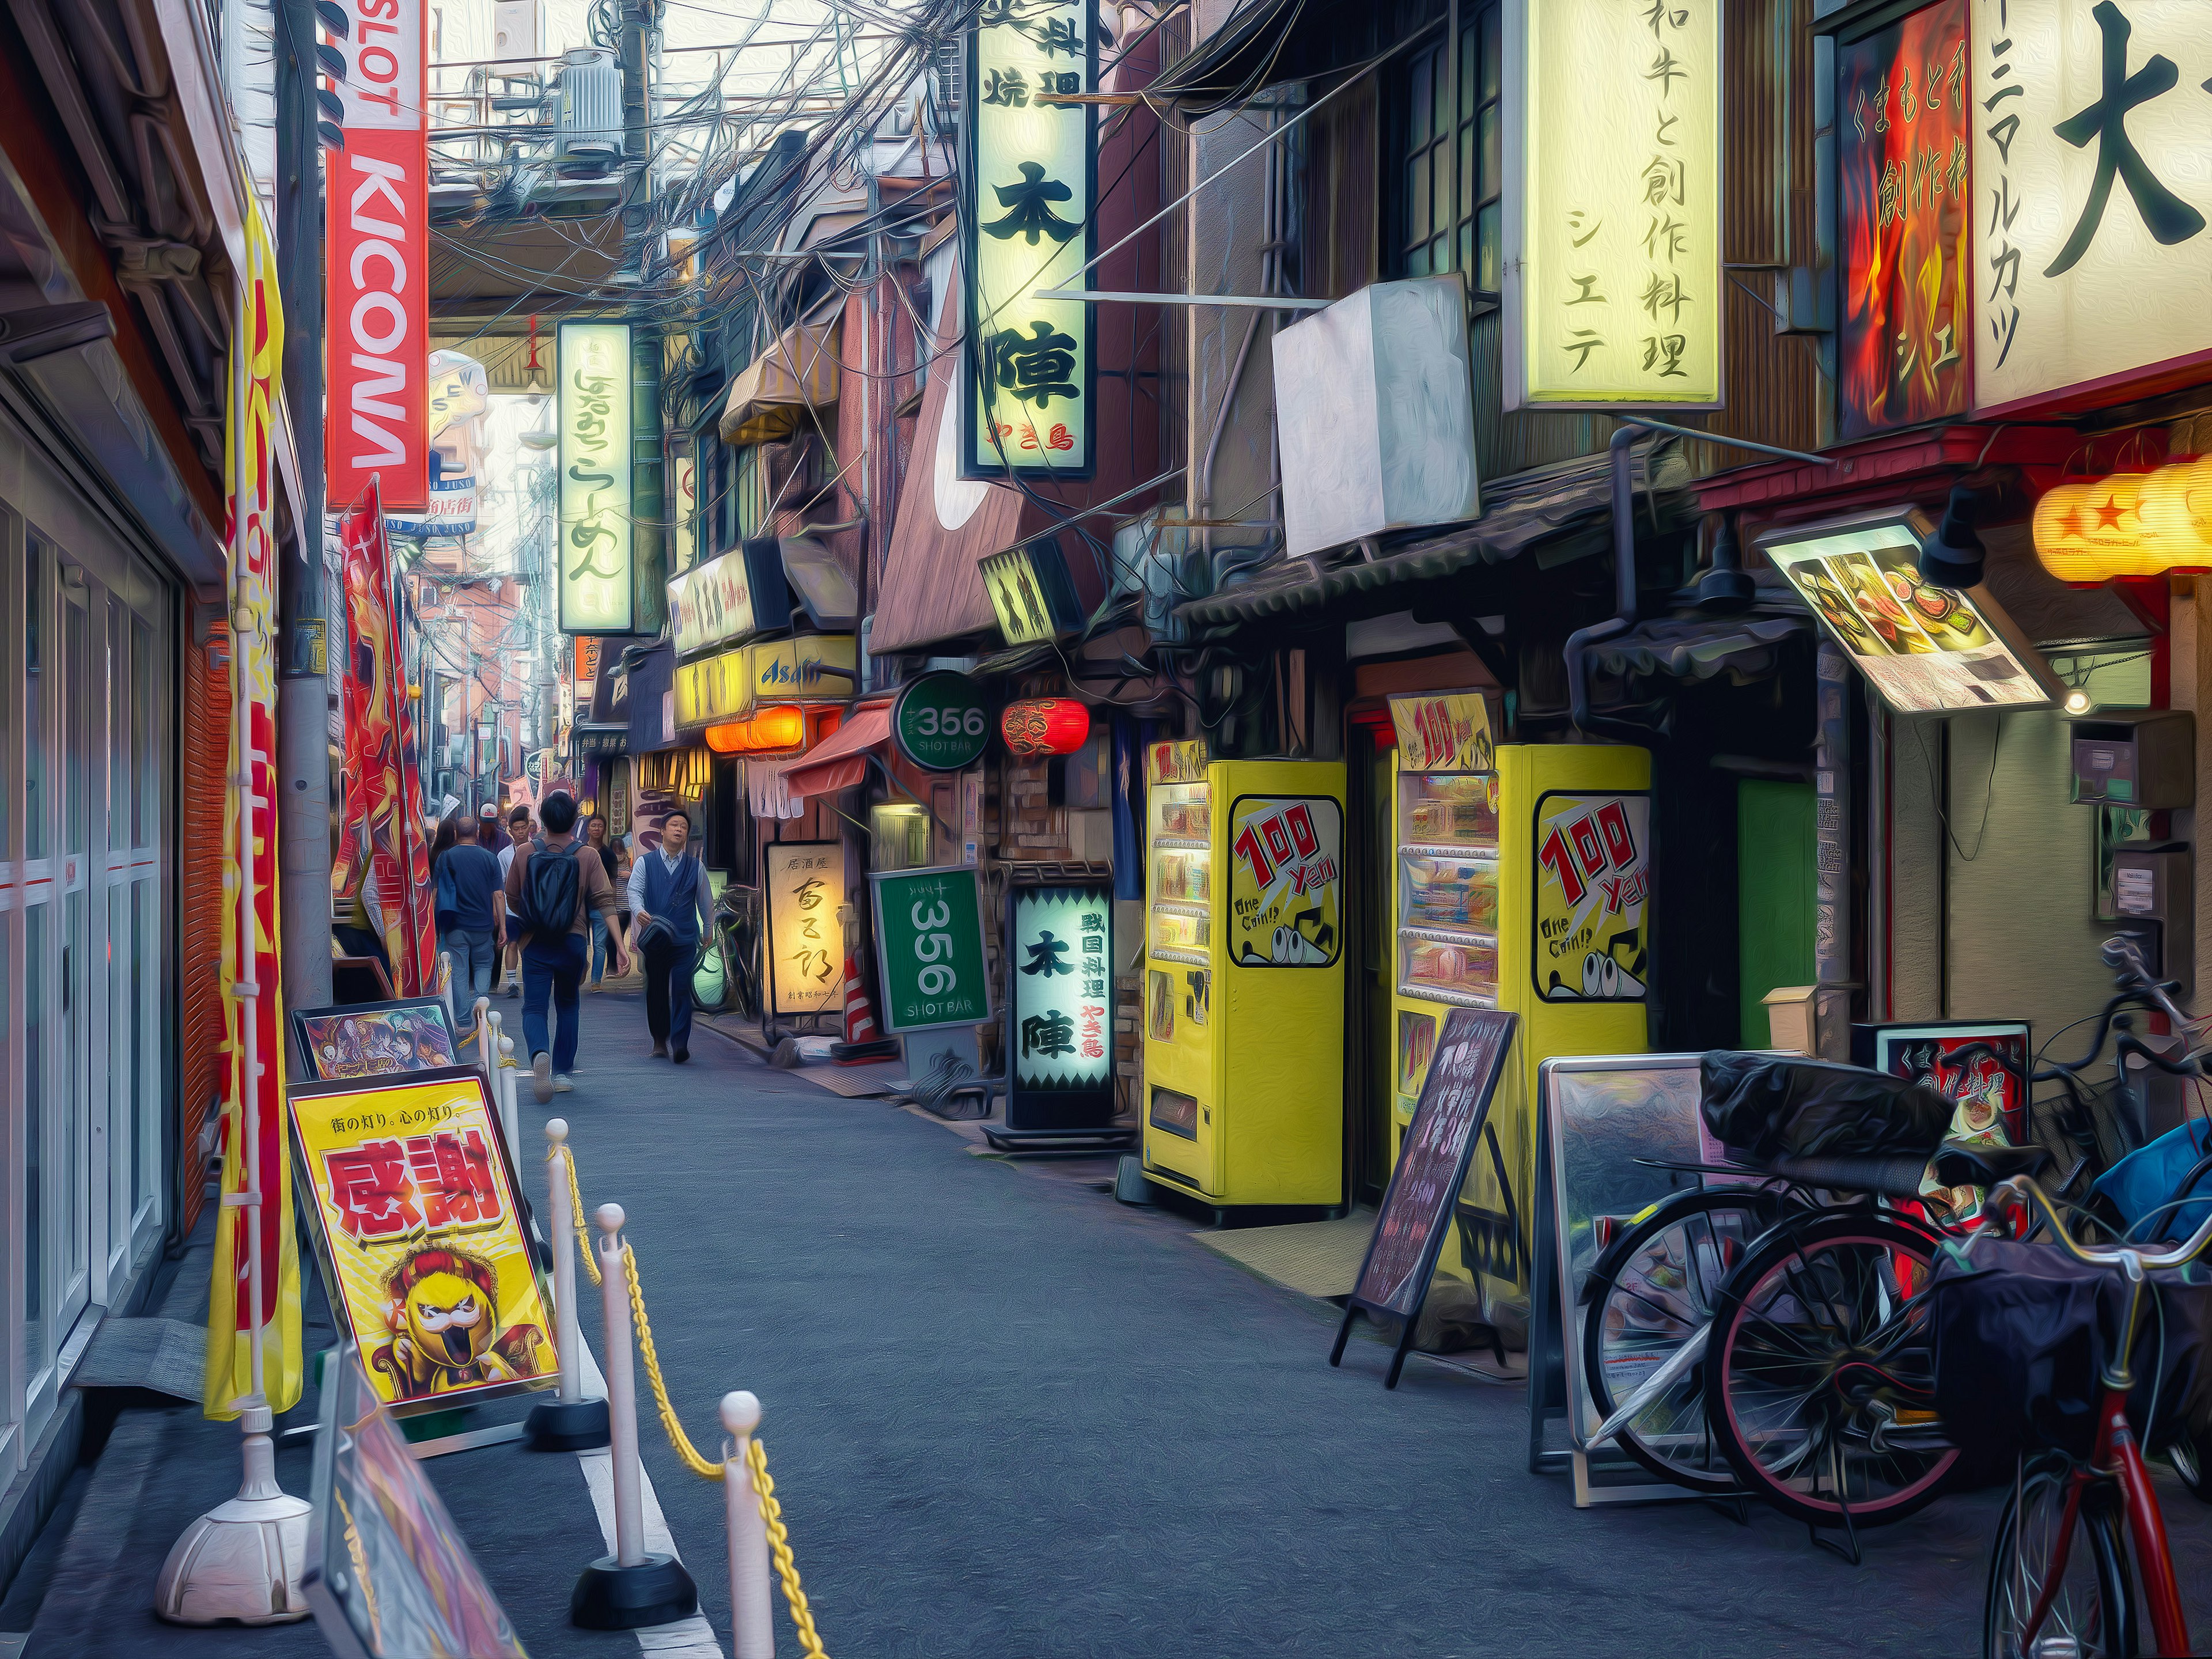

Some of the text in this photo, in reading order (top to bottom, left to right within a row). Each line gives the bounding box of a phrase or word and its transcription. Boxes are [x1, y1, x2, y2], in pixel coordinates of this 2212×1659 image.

[358, 0, 399, 116] SLOT
[1641, 0, 1694, 378] 和牛と創作料理
[350, 153, 408, 469] KICONA
[1560, 210, 1608, 374] シエテ
[986, 422, 1074, 451] やき鳥
[444, 478, 472, 490] JUSO
[444, 522, 471, 535] JUSO
[918, 707, 984, 736] 356
[1413, 698, 1456, 771] 100
[919, 741, 972, 751] SHOT BAR
[787, 857, 828, 870] 居酒屋
[1232, 801, 1321, 892] 100
[1539, 798, 1638, 910] 100
[1285, 853, 1338, 897] yen
[1597, 861, 1649, 916] yen
[1233, 897, 1260, 916] One
[1241, 906, 1280, 933] Coin!?
[911, 900, 956, 995] 356
[1539, 917, 1569, 940] One
[1548, 927, 1593, 959] Coin!?
[787, 991, 839, 1001] 創業昭和七年
[907, 999, 972, 1017] SHOT BAR
[1019, 929, 1077, 1060] 本陣
[1080, 1005, 1105, 1059] やき鳥
[1438, 1041, 1483, 1081] 不思議
[1434, 1081, 1476, 1118] 女学院
[331, 1105, 462, 1134] 街の灯り。心の灯り。
[323, 1128, 502, 1238] 感謝
